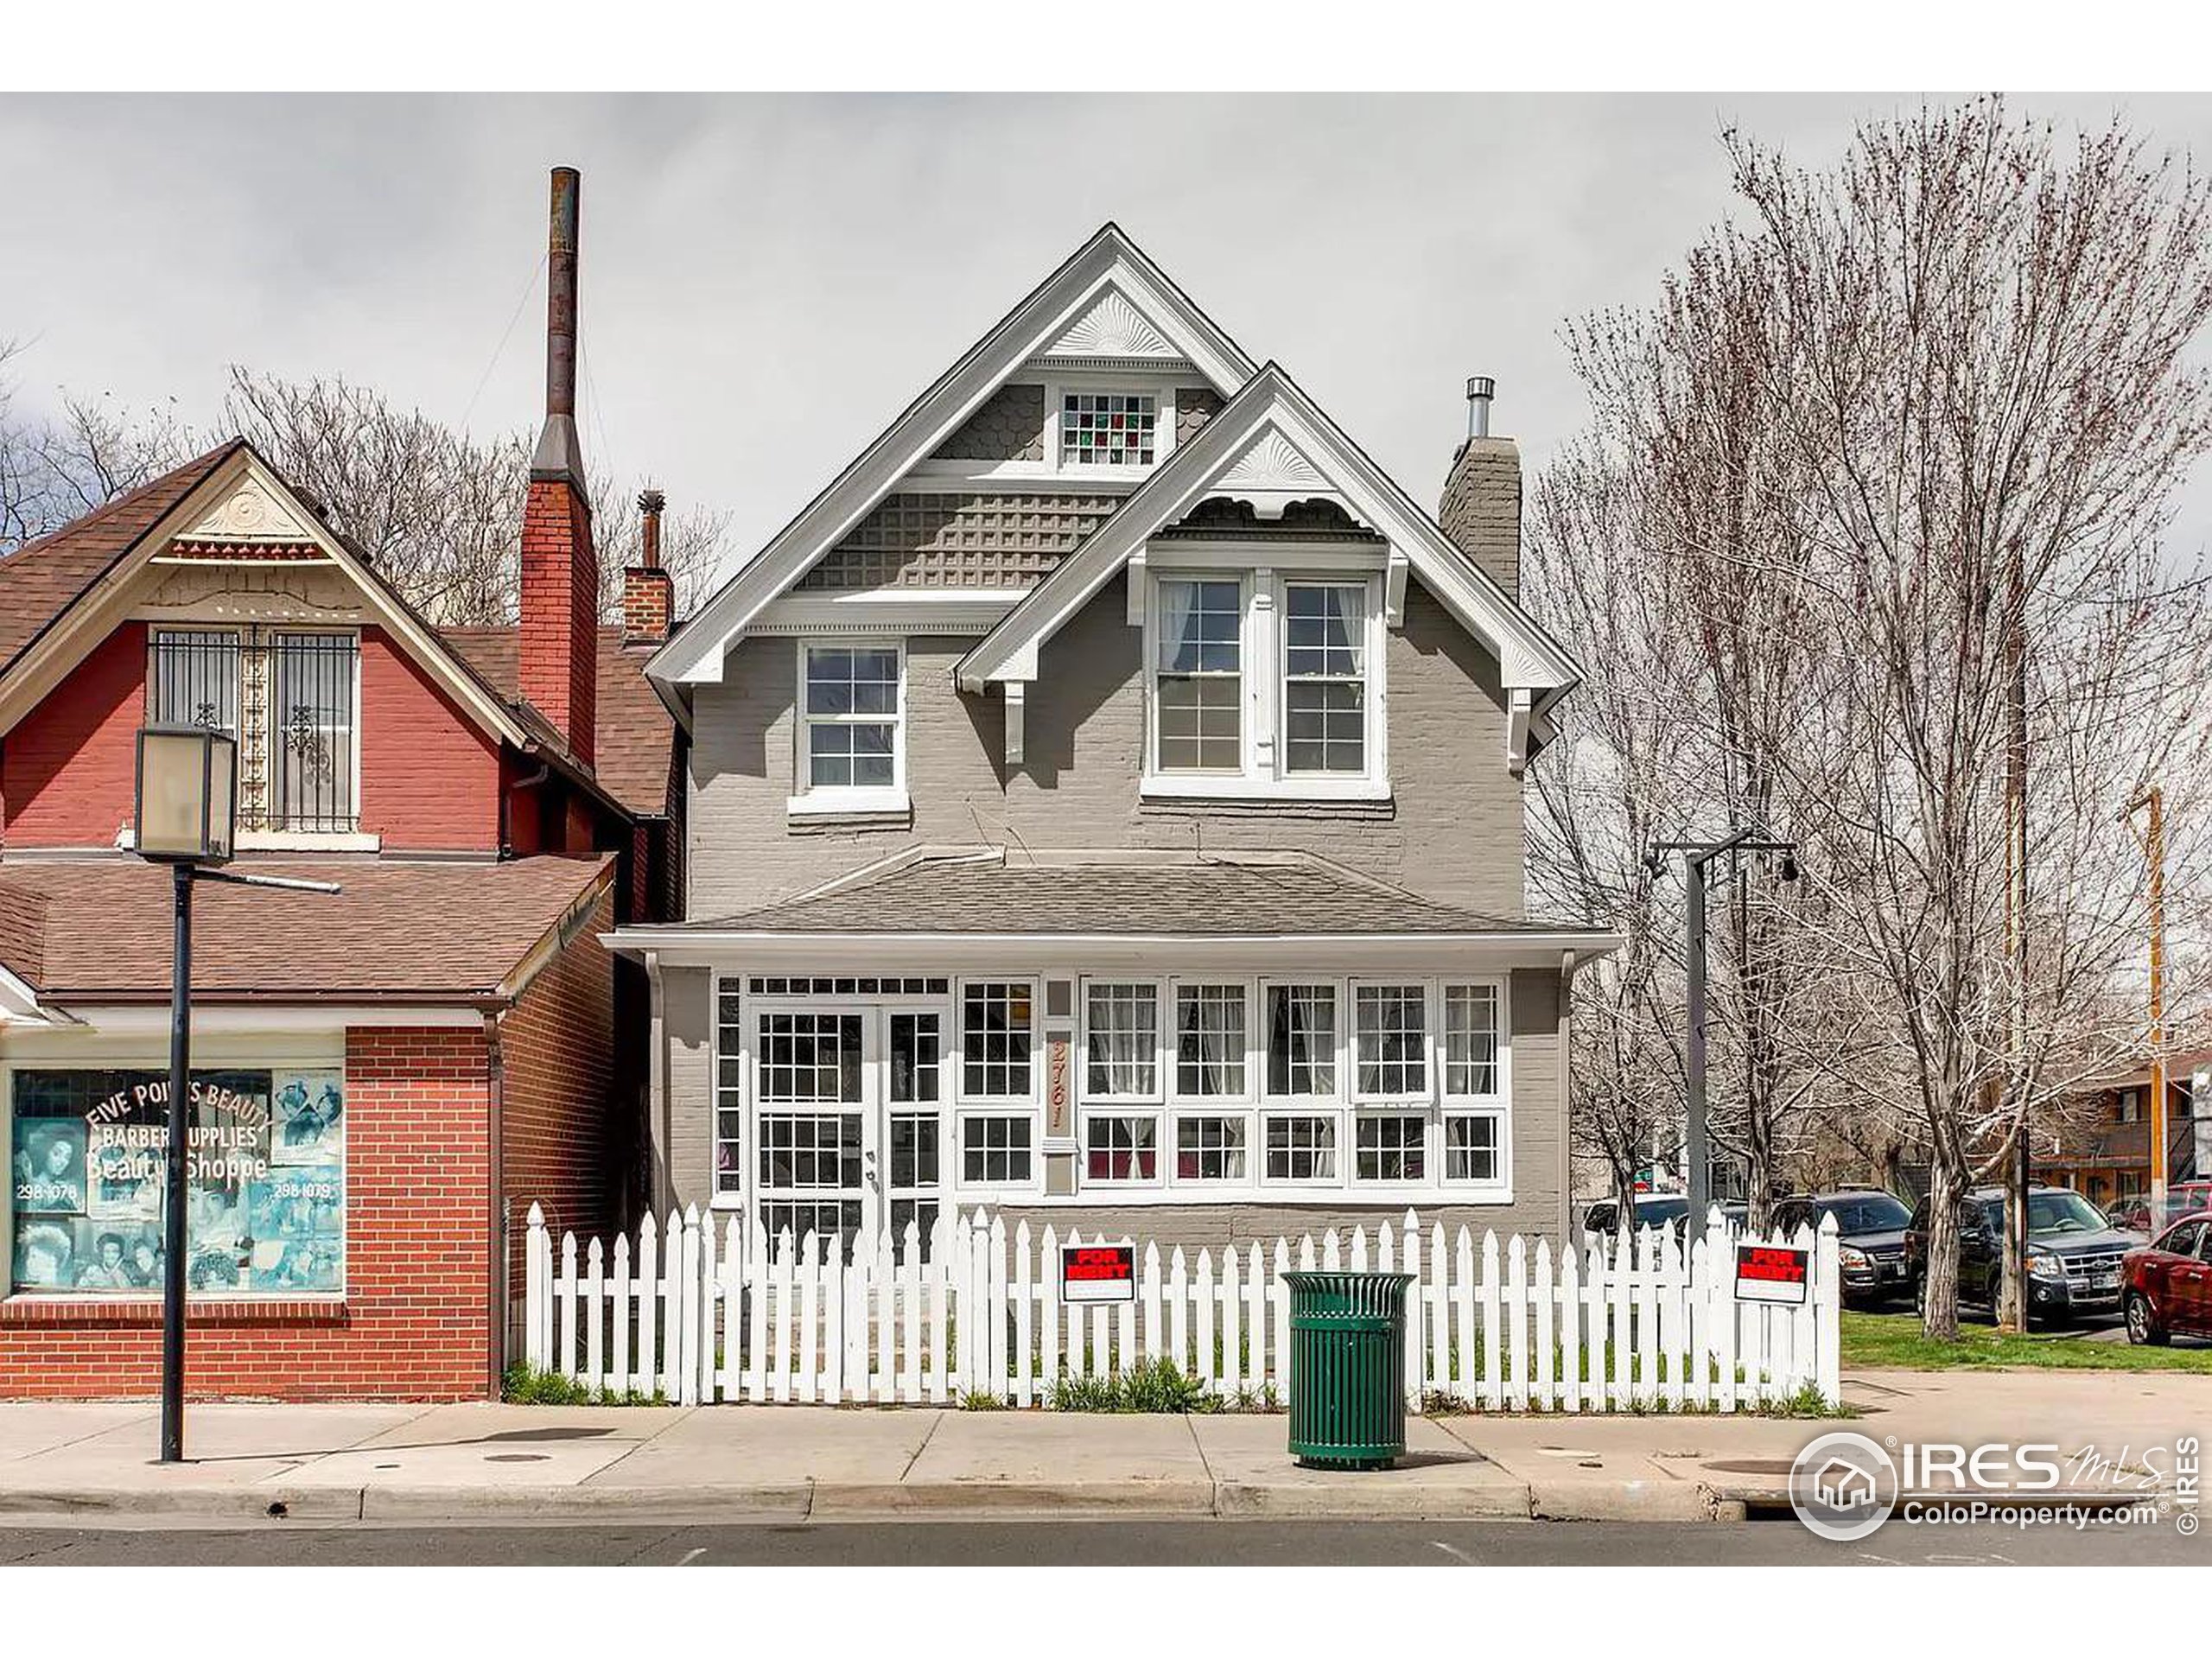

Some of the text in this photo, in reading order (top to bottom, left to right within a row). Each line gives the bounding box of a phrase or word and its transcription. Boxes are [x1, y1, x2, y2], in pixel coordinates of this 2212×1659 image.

[85, 1091, 131, 1132] FIVE
[207, 1084, 275, 1133] BEAUTY
[103, 1126, 257, 1148] BARBER UPPLIES
[1077, 1249, 1118, 1264] FOR
[1752, 1249, 1794, 1265] FOR
